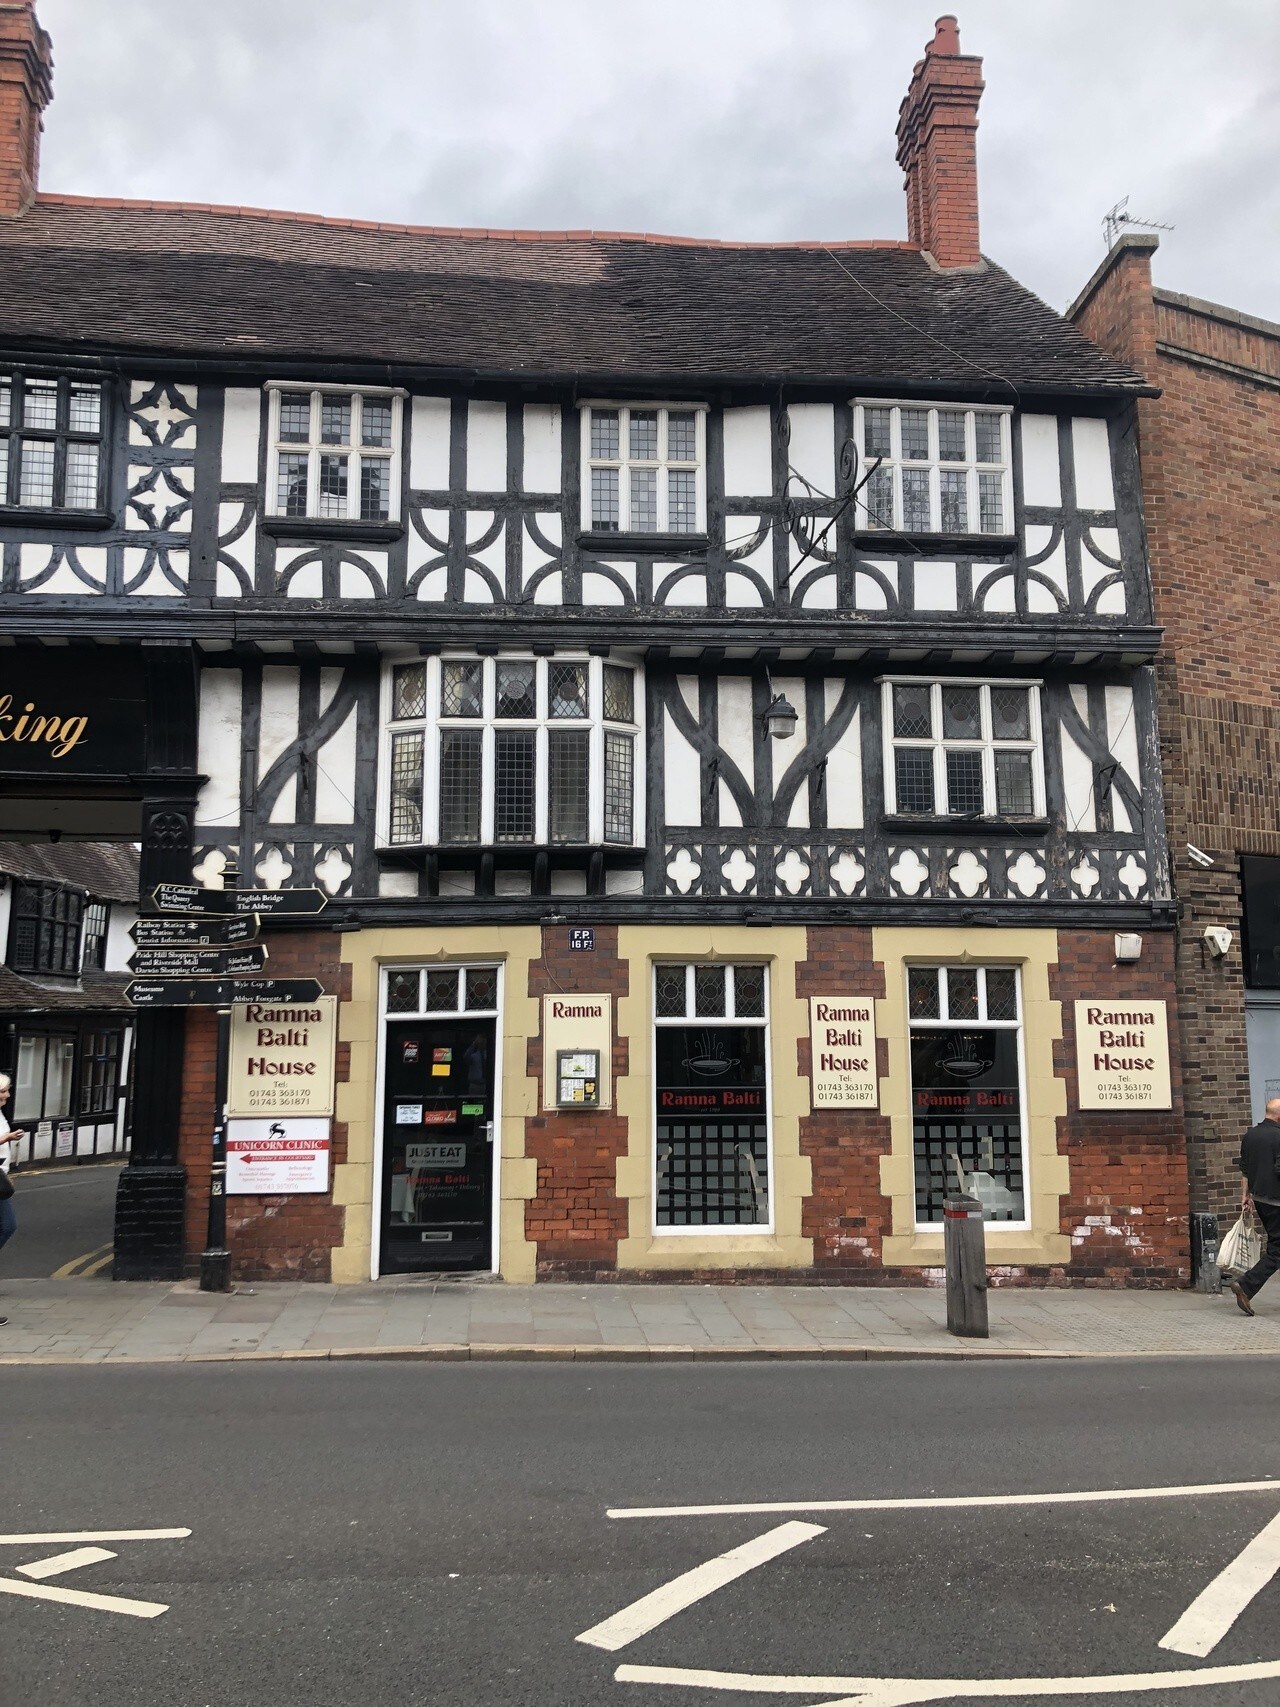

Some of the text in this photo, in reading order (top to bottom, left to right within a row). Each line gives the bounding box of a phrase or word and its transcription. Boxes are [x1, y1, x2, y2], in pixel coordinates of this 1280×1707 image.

[160, 893, 171, 901] The
[236, 894, 284, 903] English Bridge
[160, 901, 188, 911] Swimming
[251, 903, 274, 911] Abbey
[574, 930, 590, 939] F.P.
[571, 940, 581, 948] 16
[168, 951, 198, 959] Shopping
[160, 966, 191, 975] Shopping
[233, 981, 250, 989] Wyle
[251, 981, 265, 989] Cop
[233, 995, 254, 1003] Abbey
[255, 995, 283, 1003] Foregate
[246, 1004, 322, 1023] Ramna
[553, 1001, 603, 1018] Ramna
[816, 1003, 870, 1022] Ramna
[1087, 1007, 1155, 1026] Ramna
[257, 1027, 309, 1047] Balti
[826, 1028, 862, 1047] Balti
[1100, 1030, 1146, 1048] Balti
[247, 1057, 317, 1075] House
[821, 1053, 869, 1072] House
[1093, 1053, 1156, 1071] House
[838, 1074, 853, 1082] Tel:
[273, 1080, 289, 1088] Tel:
[817, 1083, 874, 1091] 01743 363170
[1097, 1083, 1152, 1091] 01743 363170
[249, 1089, 311, 1097] 01743 363170
[818, 1092, 873, 1100] 01743 361871
[1098, 1092, 1152, 1100] 01743 361871
[249, 1098, 277, 1106] 01743
[662, 1090, 760, 1106] Ramna Balti
[917, 1091, 1014, 1106] Ramna Balti
[234, 1140, 323, 1151] UNICORN CLINIC
[440, 1147, 462, 1157] EAT
[444, 1174, 470, 1184] Balti
